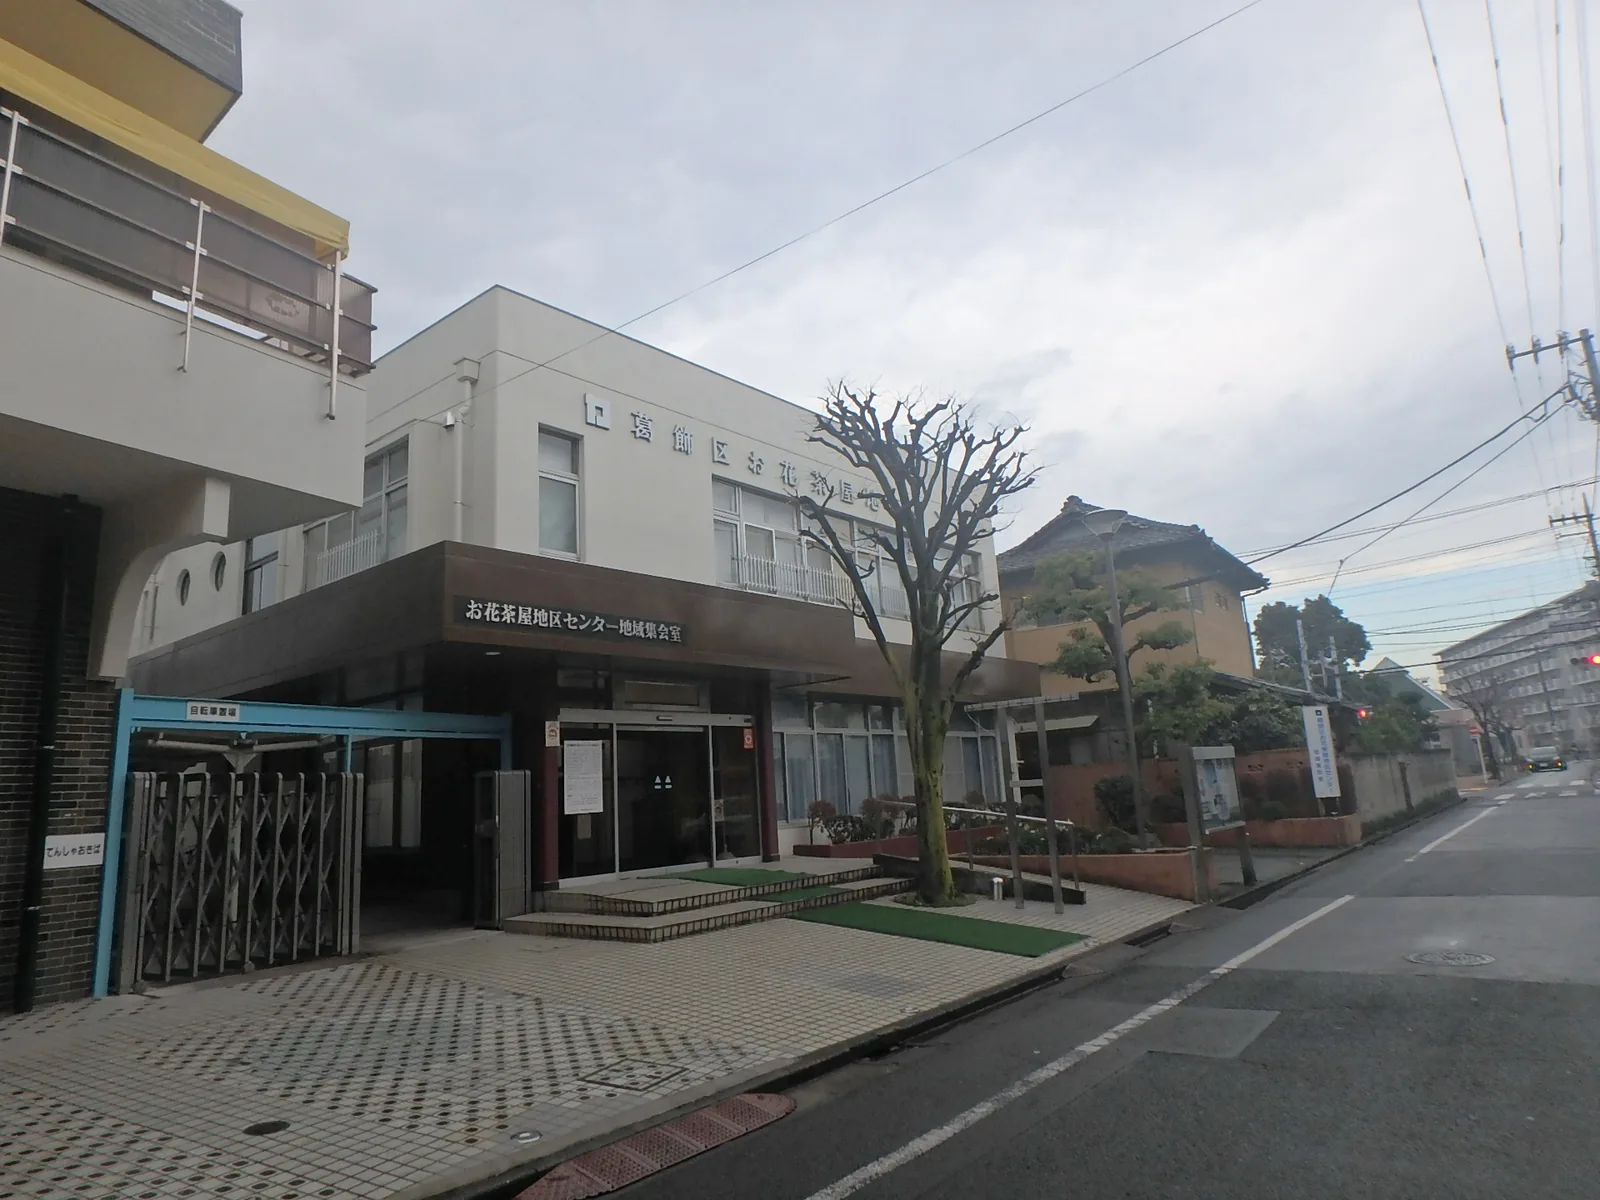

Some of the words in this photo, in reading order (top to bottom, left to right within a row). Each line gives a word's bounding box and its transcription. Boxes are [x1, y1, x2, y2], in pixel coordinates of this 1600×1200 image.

[465, 599, 682, 643] お花茶屋地区センター地域集会室
[190, 705, 237, 717] 自転車置場
